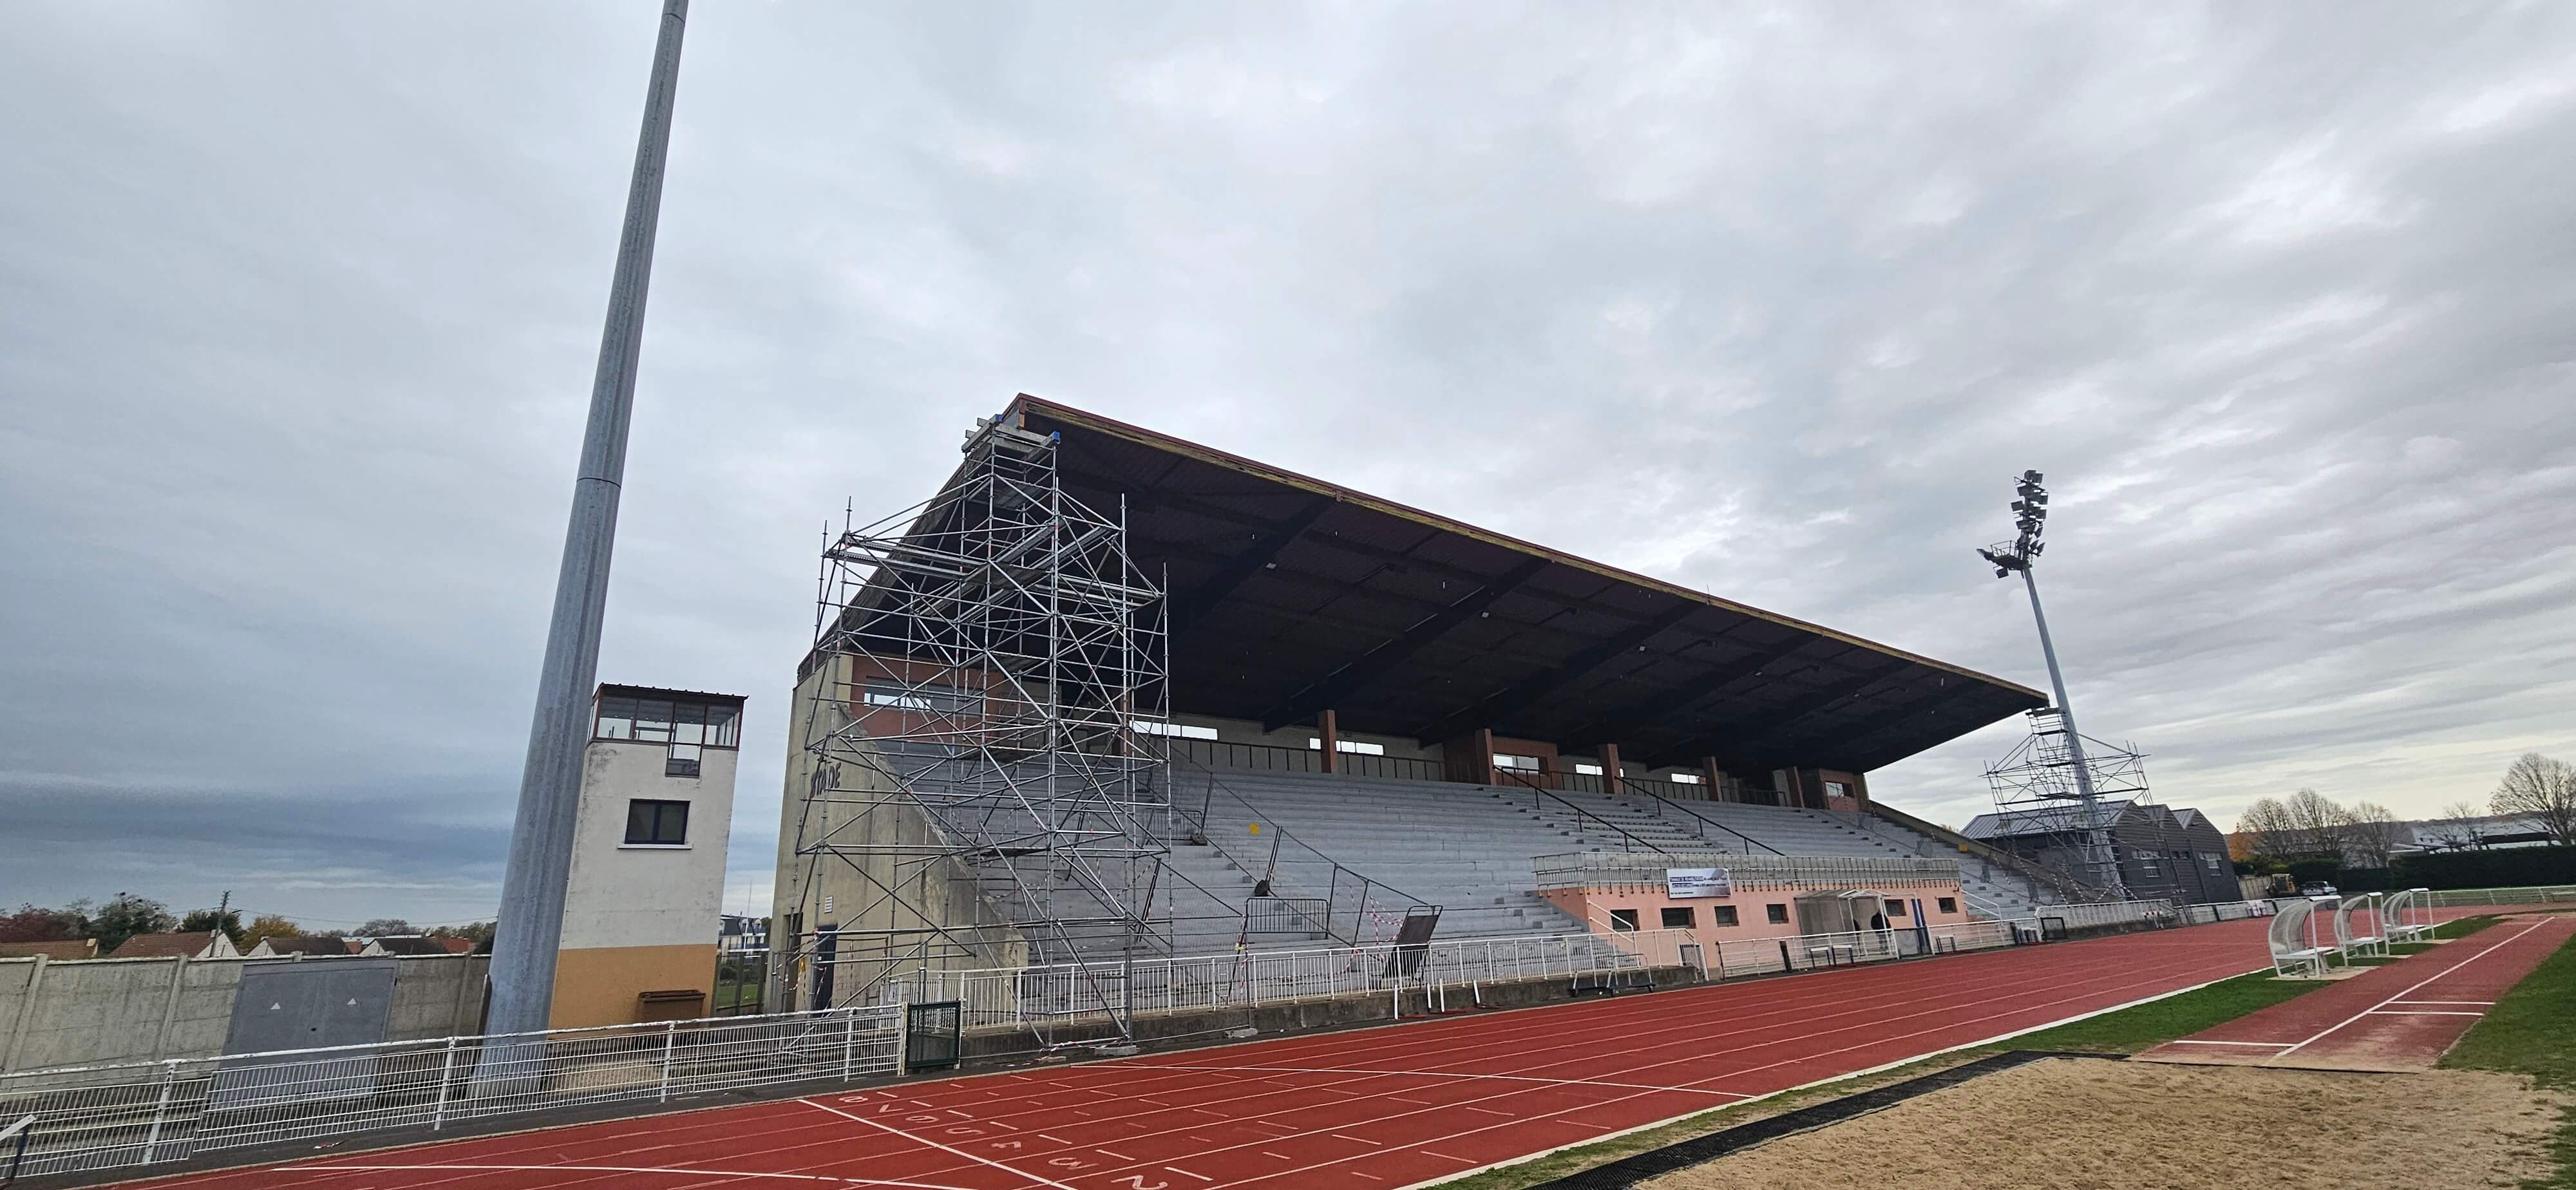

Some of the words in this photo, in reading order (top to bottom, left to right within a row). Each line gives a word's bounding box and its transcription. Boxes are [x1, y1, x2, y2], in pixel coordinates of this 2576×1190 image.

[878, 1103, 904, 1113] 7
[1048, 1157, 1099, 1169] 3
[1110, 1175, 1168, 1190] 2
